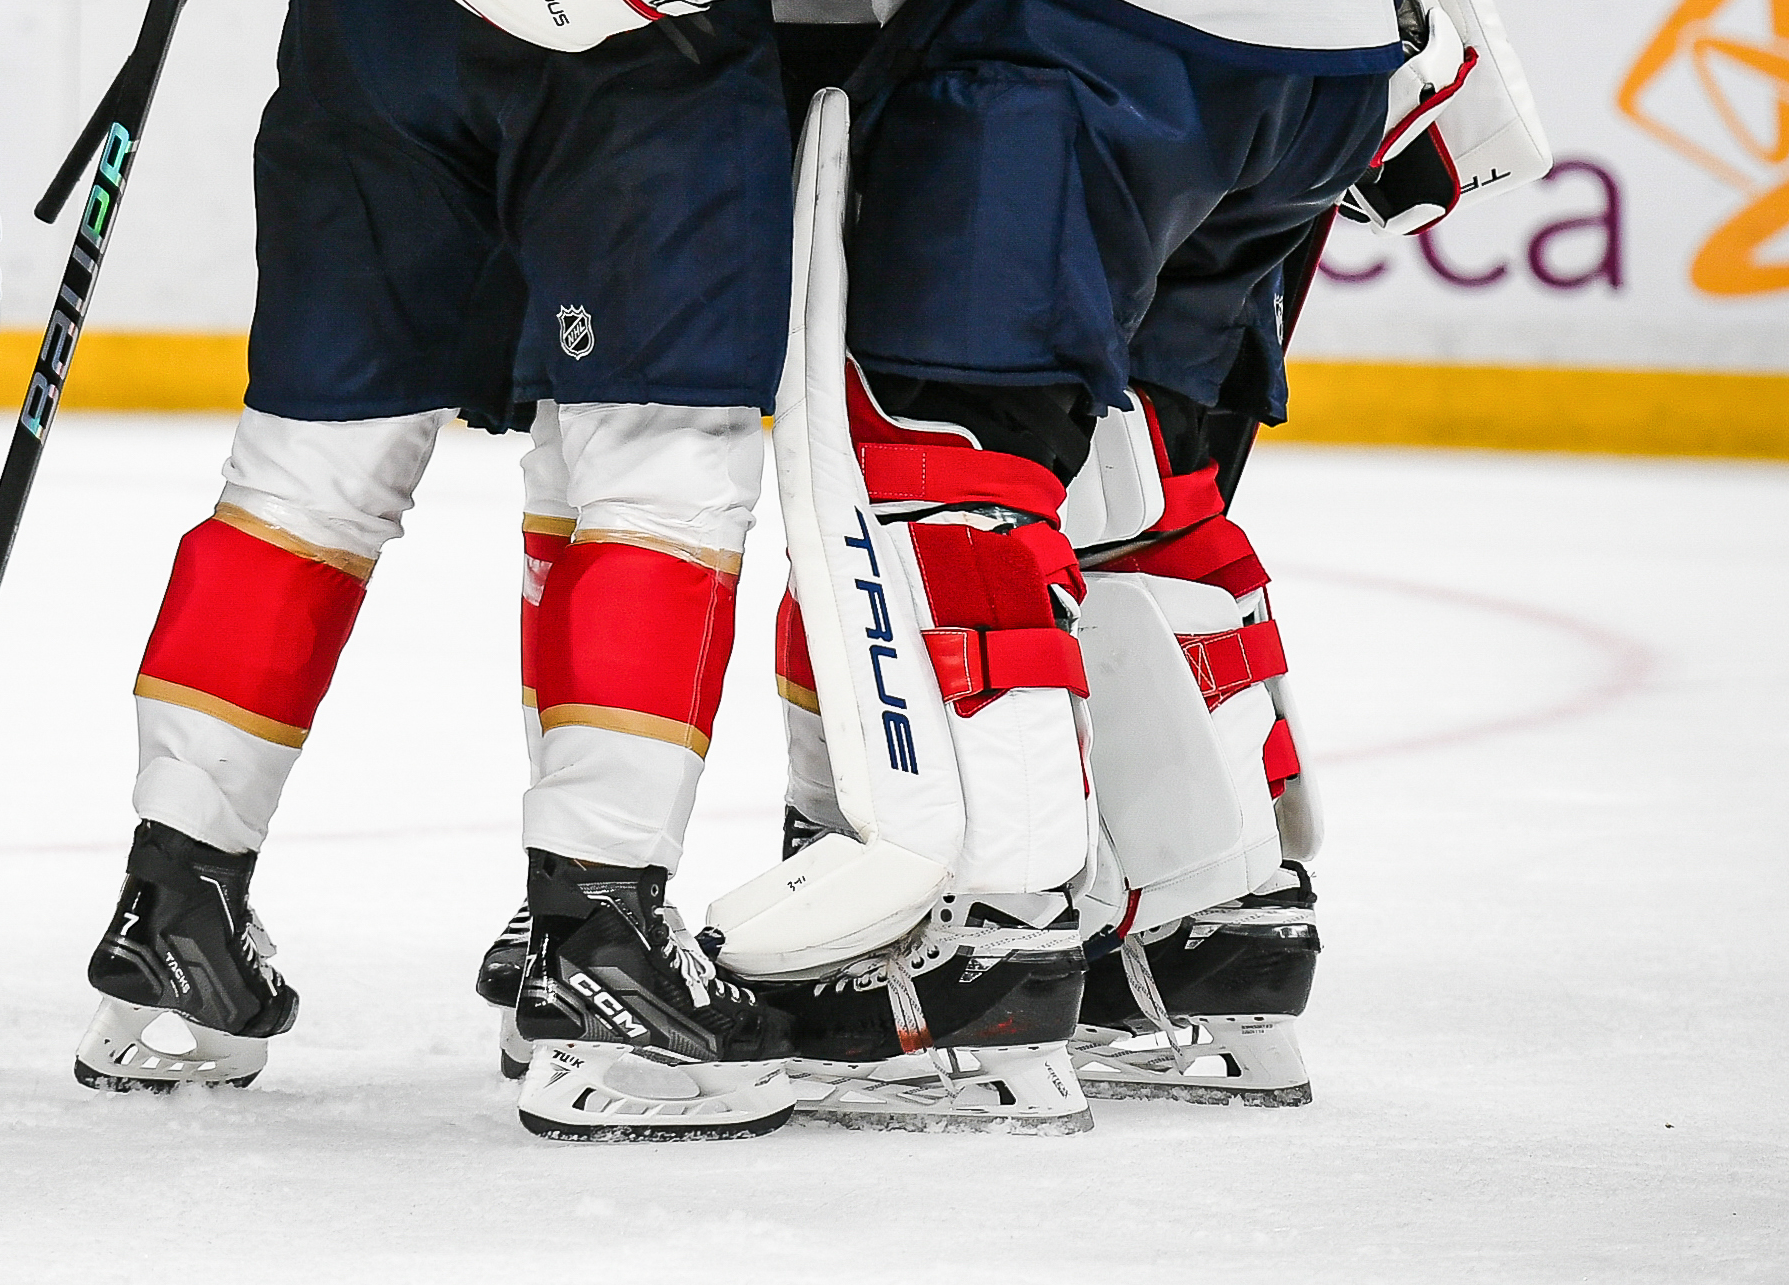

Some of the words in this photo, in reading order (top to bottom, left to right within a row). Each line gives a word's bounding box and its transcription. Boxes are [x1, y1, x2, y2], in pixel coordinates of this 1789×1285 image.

[567, 321, 586, 347] NHL
[842, 504, 920, 777] TRUE
[119, 911, 140, 936] 7
[165, 950, 192, 995] TACKS
[568, 971, 650, 1039] CCM
